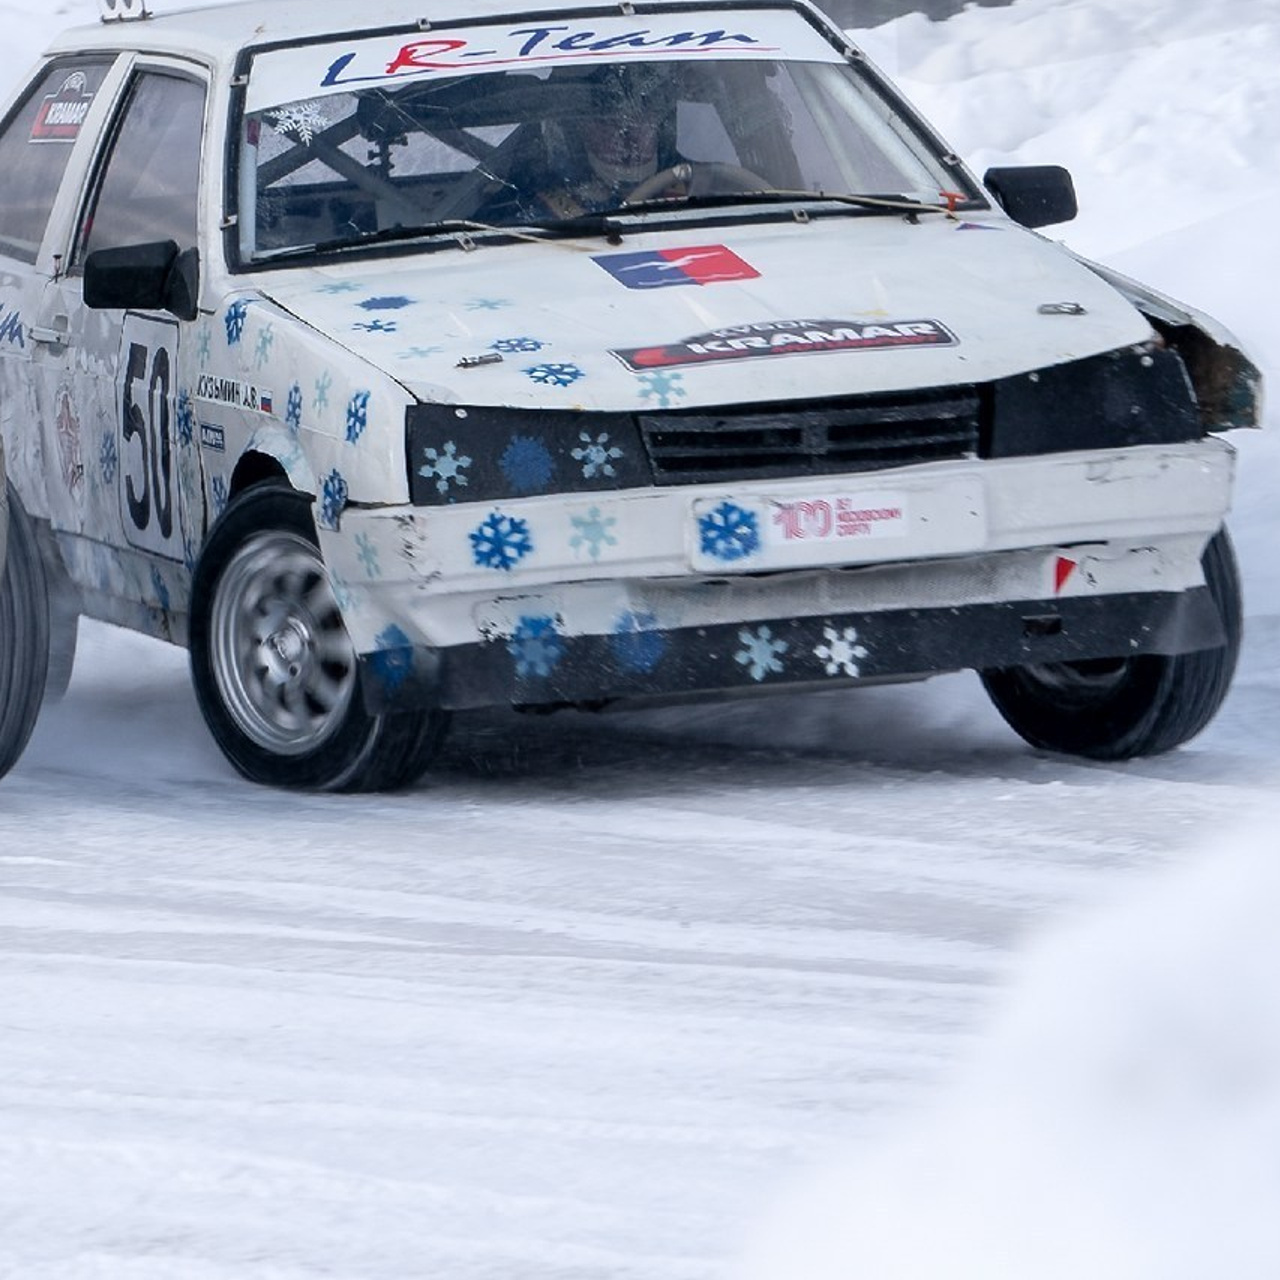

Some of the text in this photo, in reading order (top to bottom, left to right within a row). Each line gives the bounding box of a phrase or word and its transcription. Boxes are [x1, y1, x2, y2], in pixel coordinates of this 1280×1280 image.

[45, 102, 88, 124] KRAMAR
[686, 323, 939, 355] KRAMAR
[123, 342, 172, 540] 50
